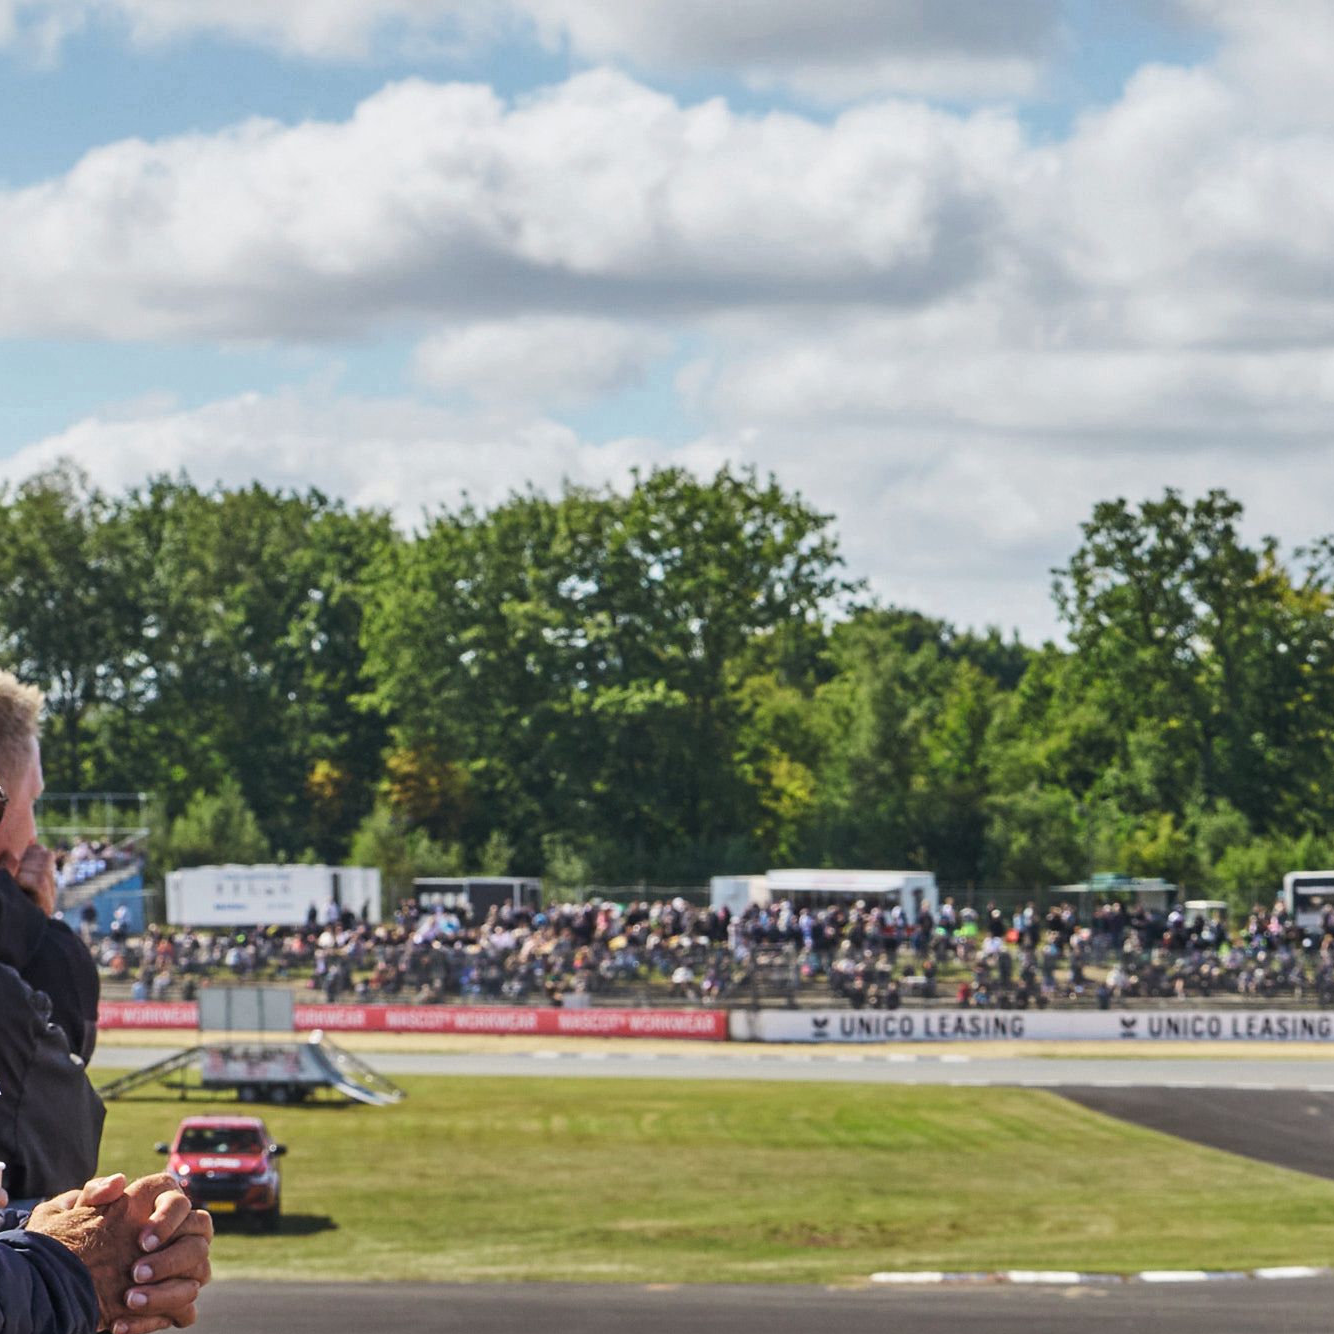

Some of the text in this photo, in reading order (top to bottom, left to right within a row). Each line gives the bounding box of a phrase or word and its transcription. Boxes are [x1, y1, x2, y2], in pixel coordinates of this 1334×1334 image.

[295, 1008, 366, 1027] ORKWEAR
[840, 1015, 1025, 1038] UNICO LEASING
[1148, 1015, 1332, 1038] UNICO LEASING
